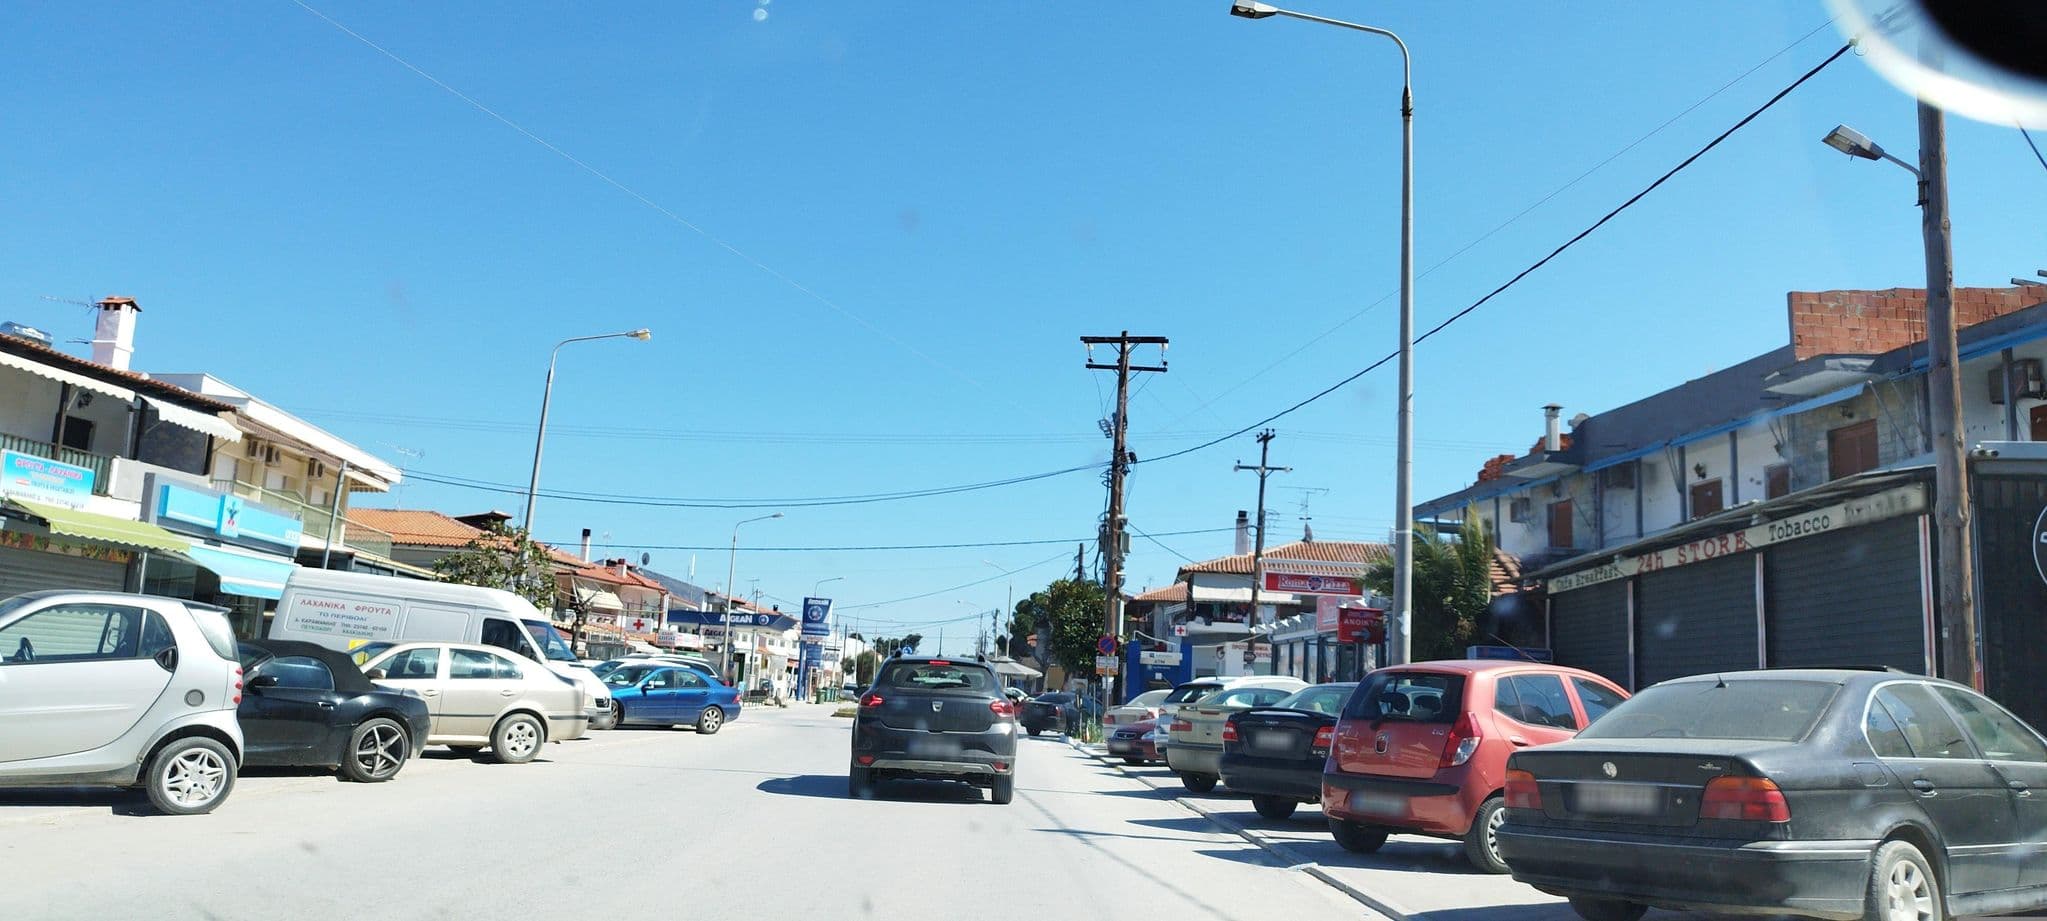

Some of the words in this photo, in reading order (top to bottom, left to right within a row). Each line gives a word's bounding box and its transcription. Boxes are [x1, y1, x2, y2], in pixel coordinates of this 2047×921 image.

[1637, 552, 1665, 573] 24h
[1678, 533, 1746, 565] STORE
[1768, 515, 1830, 541] Tobacco
[300, 599, 346, 611] ΛΑΧΑΝΙΚΑ
[354, 606, 392, 616] ΦΡΟΥΤΑ
[719, 614, 753, 623] AGEAN
